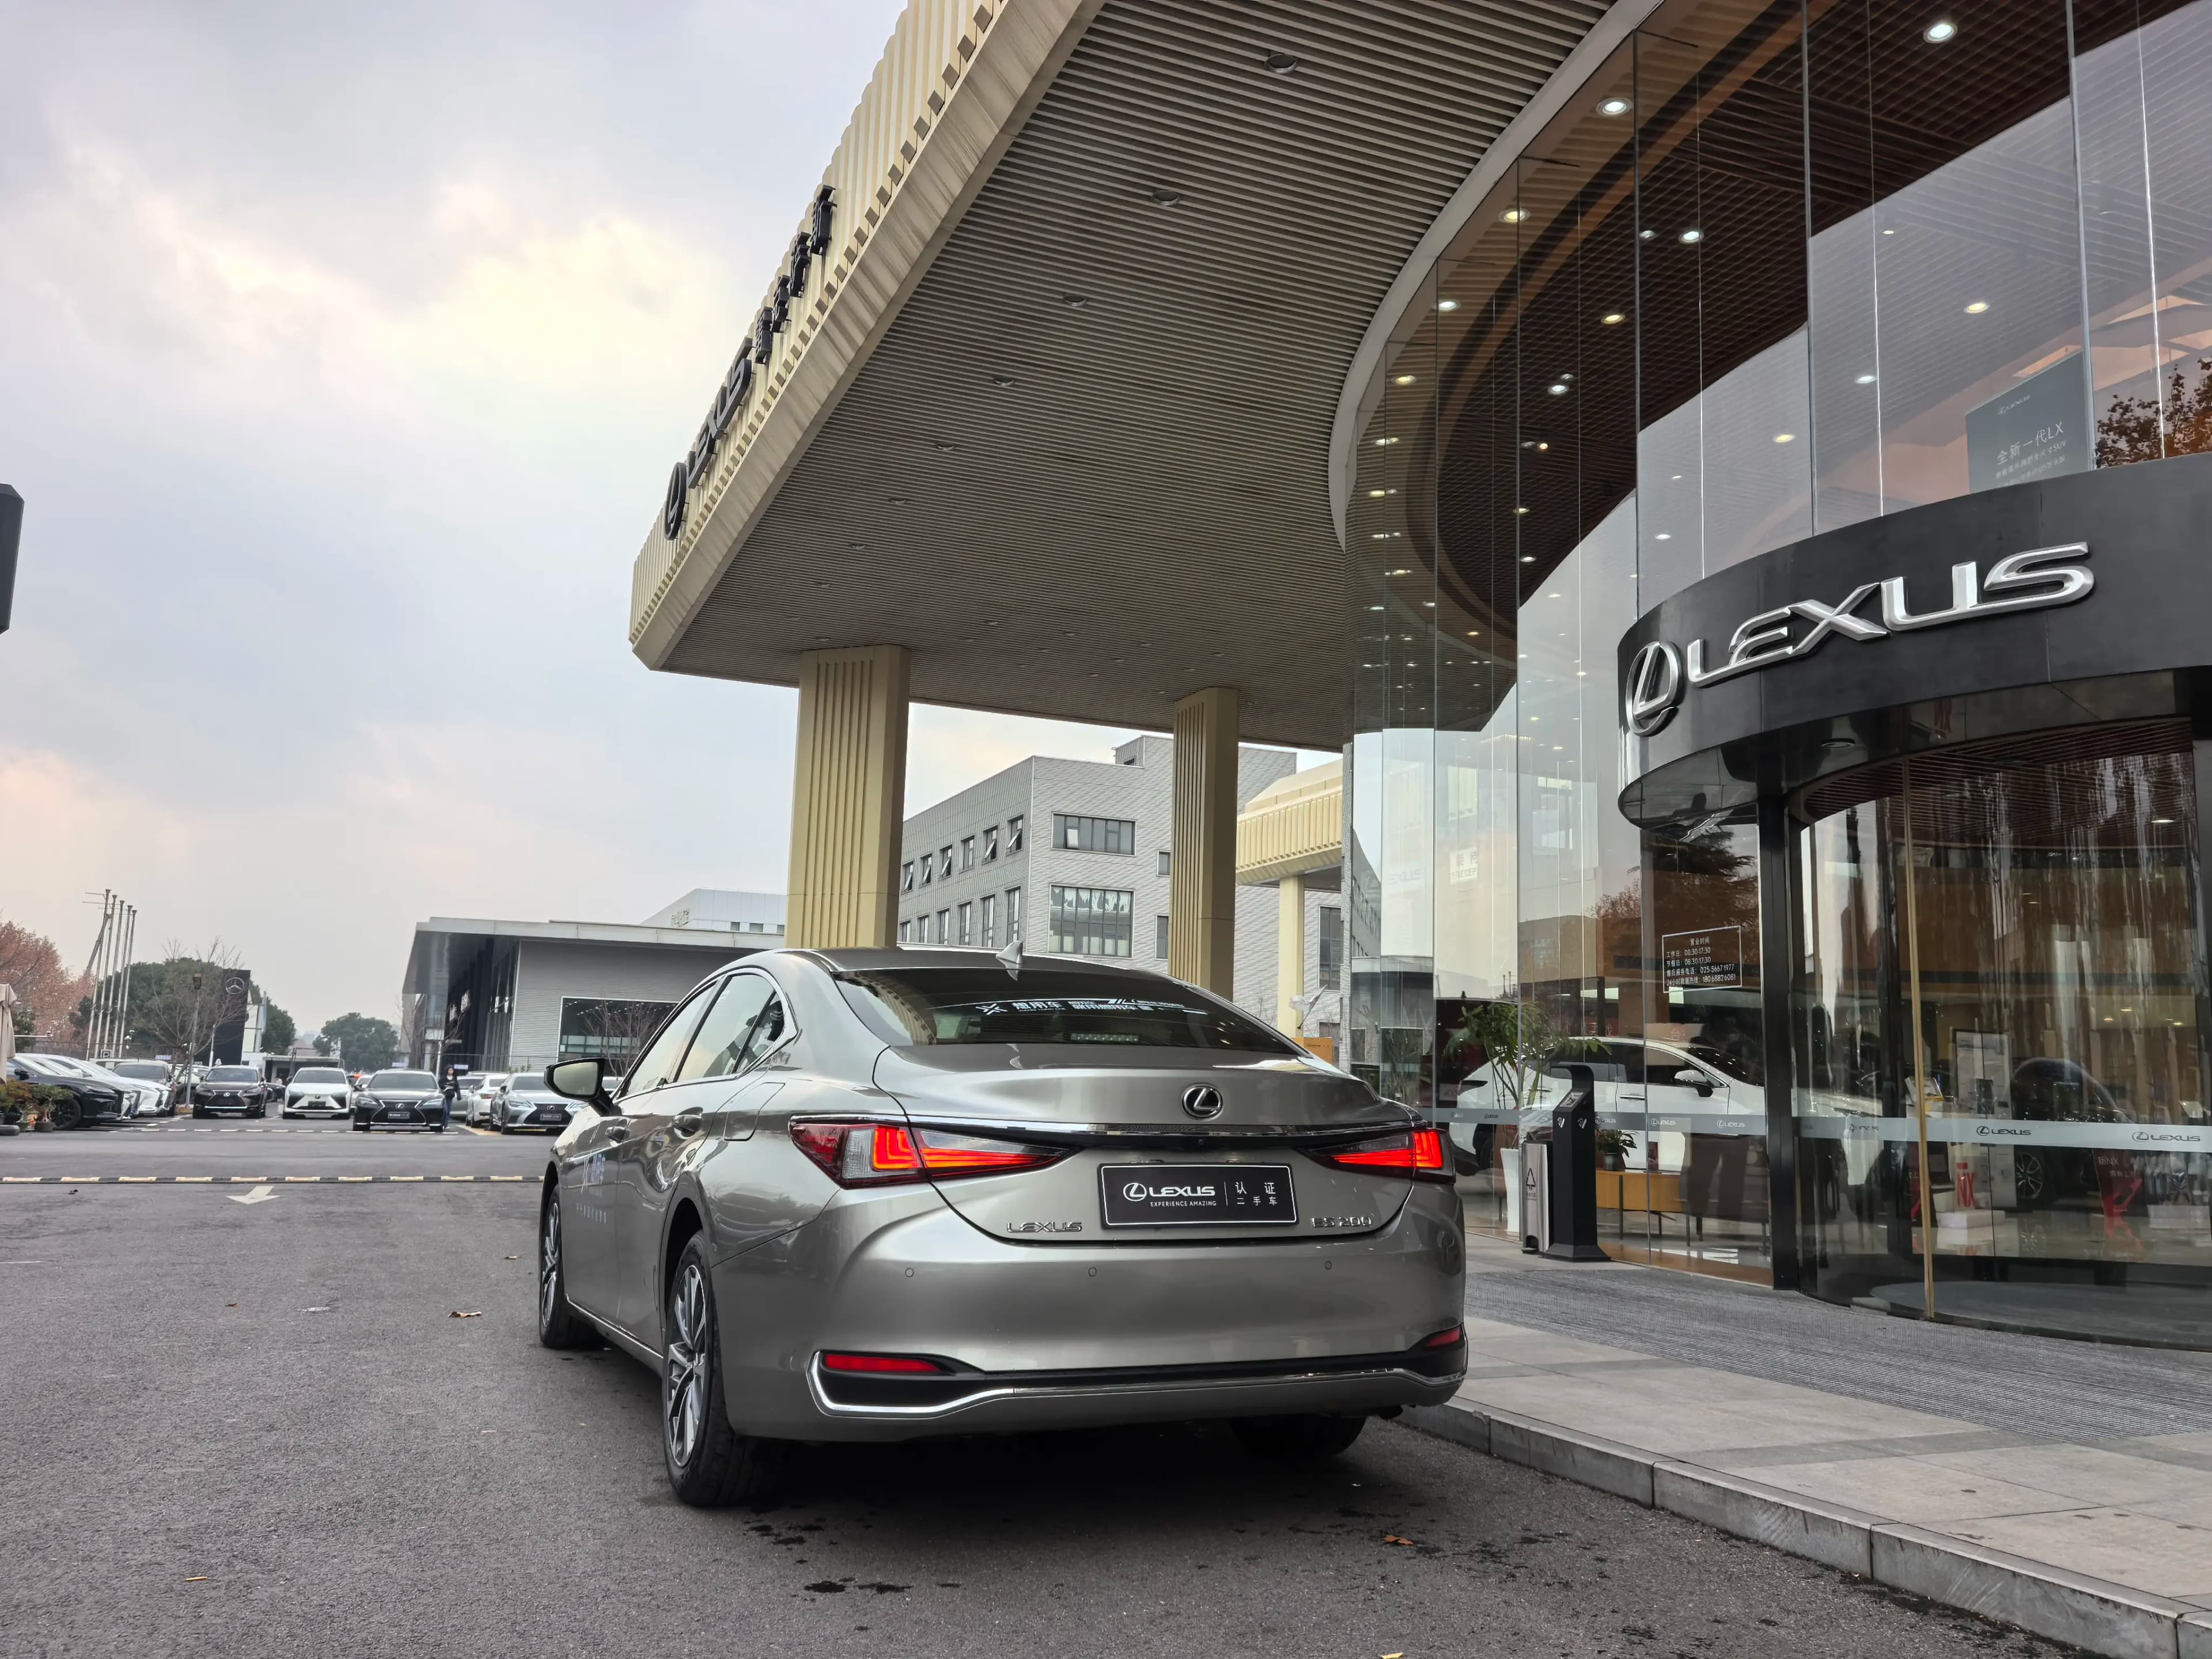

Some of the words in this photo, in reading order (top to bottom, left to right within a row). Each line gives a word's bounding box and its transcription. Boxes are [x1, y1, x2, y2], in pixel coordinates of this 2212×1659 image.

[685, 337, 754, 489] LEXUS
[1997, 421, 2064, 465] 全新一代LX
[1687, 541, 2094, 688] LEXUS
[1690, 937, 1710, 945] 营业时间
[1149, 1186, 1215, 1197] LEXUS
[1235, 1181, 1276, 1194] 认证
[1237, 1196, 1277, 1206] 二手车
[1006, 1221, 1082, 1233] LEXUS
[1310, 1217, 1335, 1228] ES
